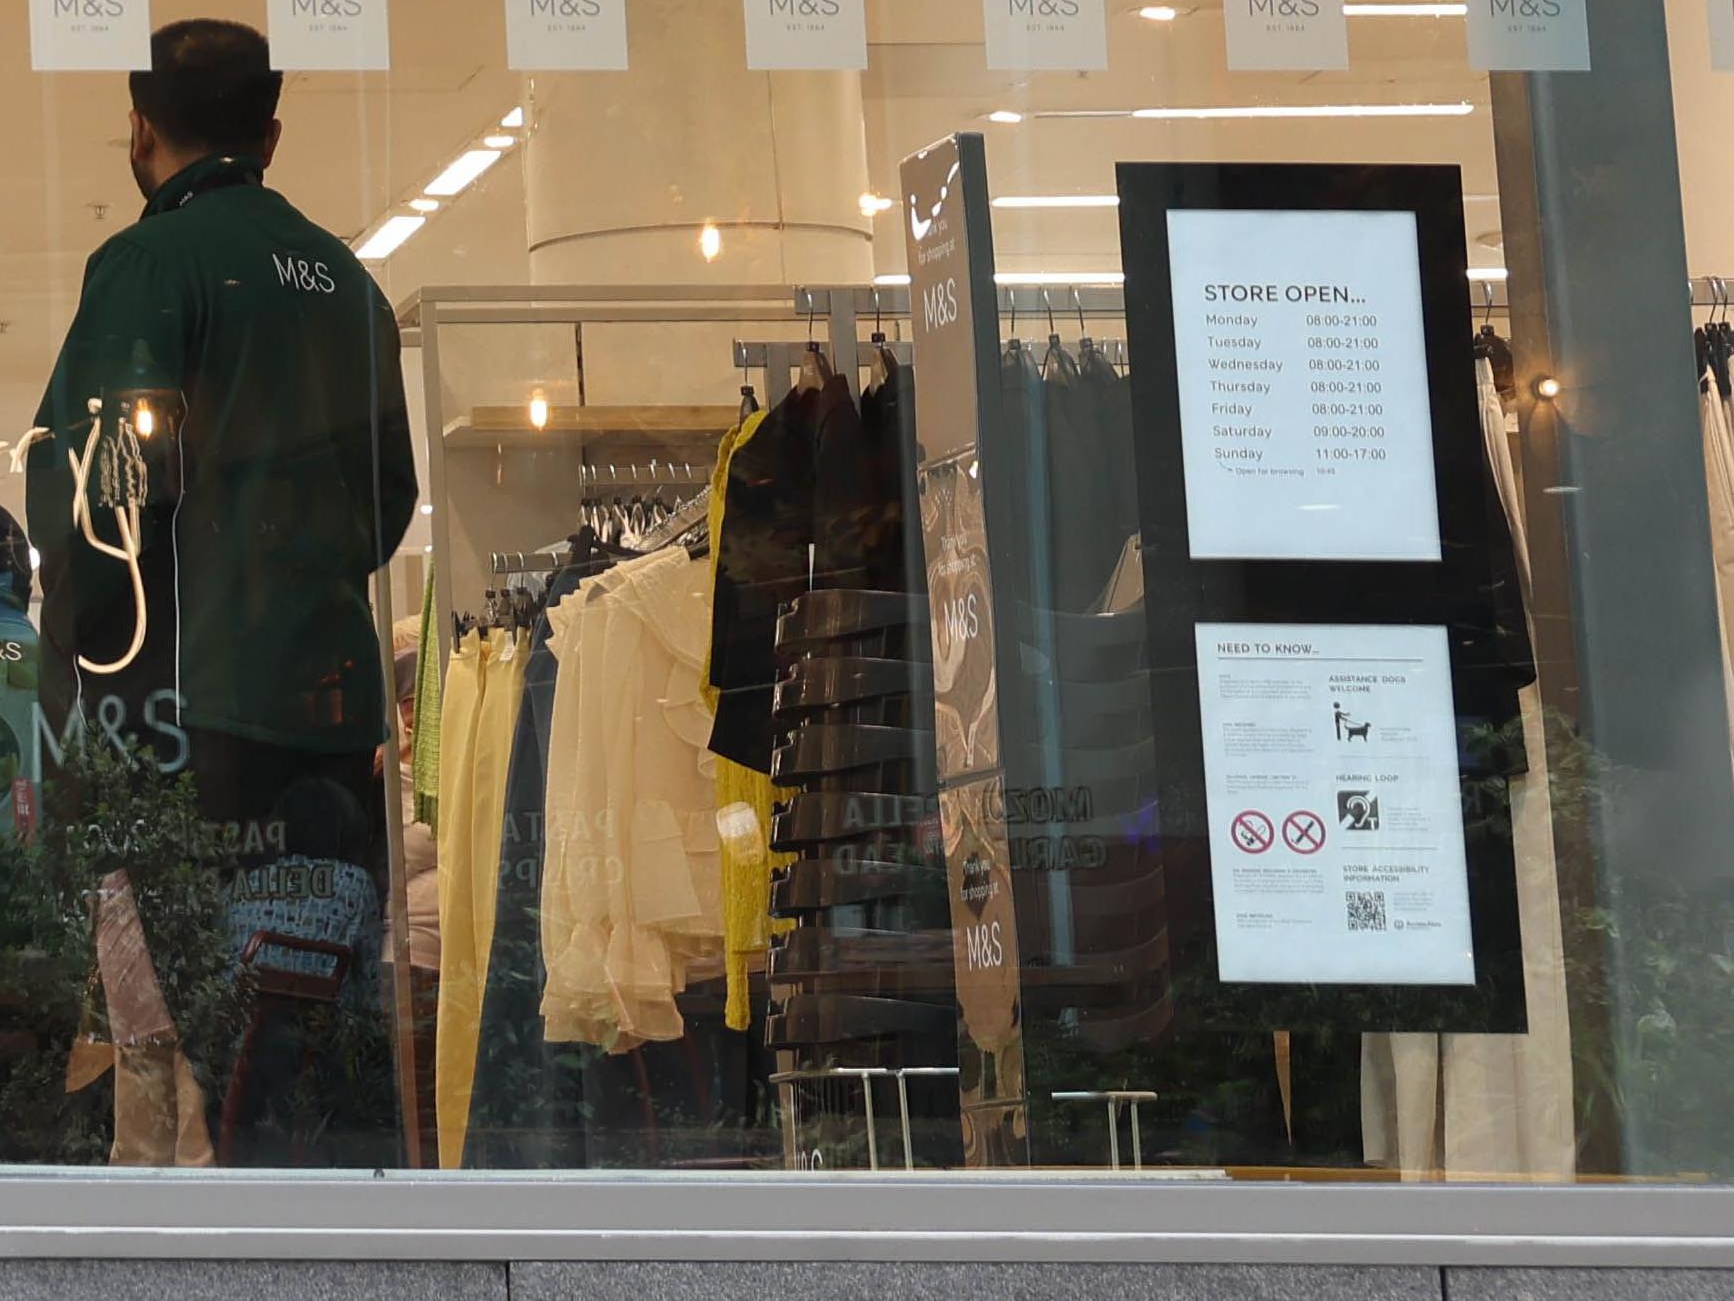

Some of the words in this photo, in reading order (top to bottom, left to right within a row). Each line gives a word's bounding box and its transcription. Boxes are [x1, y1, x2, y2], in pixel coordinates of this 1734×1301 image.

[272, 253, 336, 293] M&S
[1205, 284, 1278, 302] STORE
[1285, 285, 1365, 303] OPEN...
[924, 277, 957, 333] M&S
[1206, 314, 1258, 327] Monday
[1306, 315, 1377, 327] 08:00-21:00
[1207, 336, 1261, 349] Tuesday
[1307, 337, 1378, 349] 08:00-21:00
[1208, 358, 1283, 371] Wednesday
[1309, 359, 1380, 371] 08:00-21:00
[1210, 380, 1271, 394] Thursday
[1310, 381, 1382, 393] 08:00-21:00
[1211, 403, 1252, 417] Friday
[1312, 403, 1383, 415] 08:00-21:00
[1212, 425, 1272, 439] Saturday
[1313, 426, 1385, 438] 09:00-20:00
[1214, 447, 1263, 461] Sunday
[1316, 448, 1386, 460] 11:00-17:00
[944, 593, 978, 645] M&S
[1217, 643, 1250, 654] NEED
[1255, 644, 1271, 654] TO
[1329, 675, 1378, 684] ASSISTANCE
[1329, 685, 1371, 694] WELCOME
[1336, 774, 1372, 784] HEARING
[1375, 774, 1399, 783] LOOP
[1343, 865, 1368, 874] STORE
[1343, 874, 1399, 883] INFORMATION
[967, 921, 1002, 972] M&S
